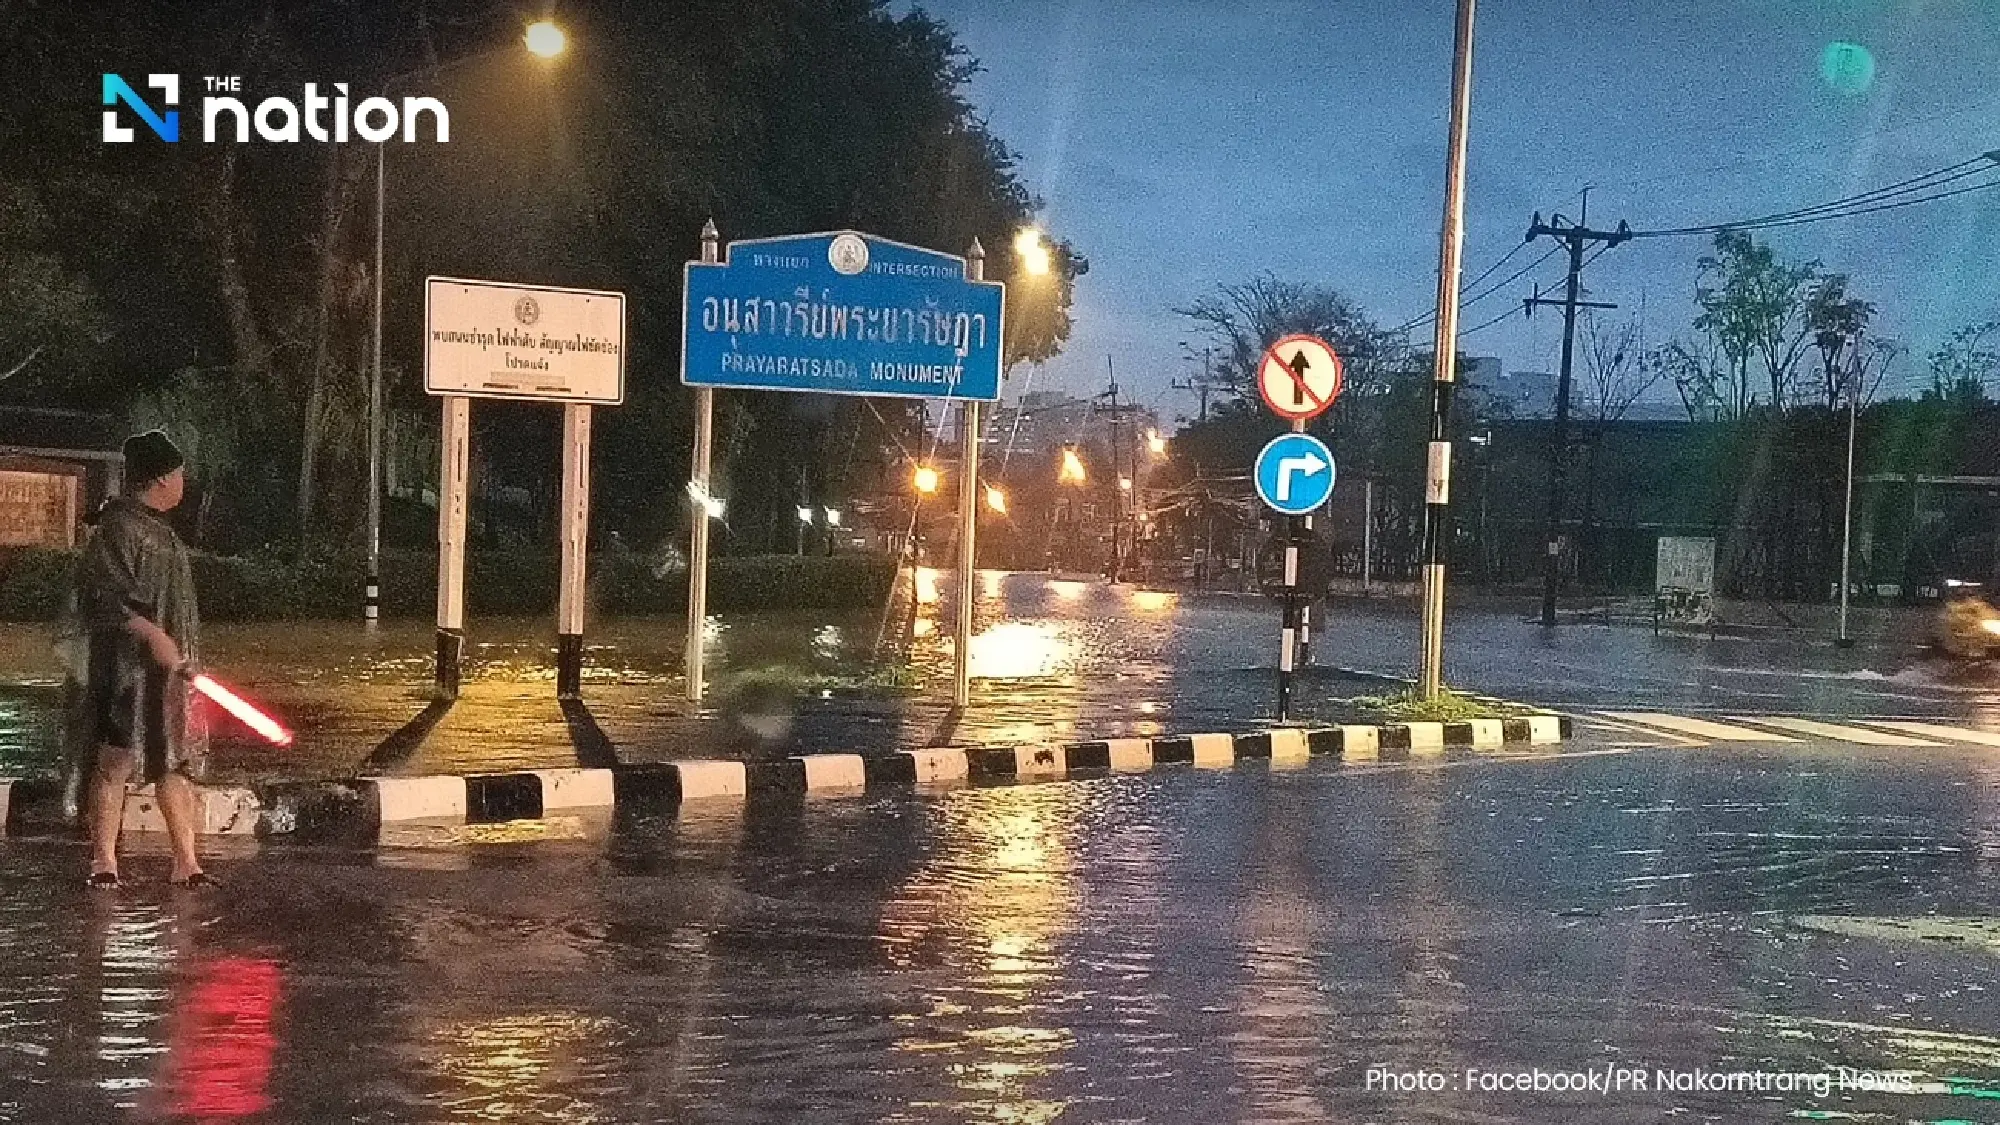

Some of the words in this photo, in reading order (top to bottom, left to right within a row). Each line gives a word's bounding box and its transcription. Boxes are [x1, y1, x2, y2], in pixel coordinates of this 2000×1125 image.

[869, 261, 959, 278] INTERSECTION
[721, 352, 858, 378] PRAYARATSADA
[870, 361, 964, 384] MONUMENT
